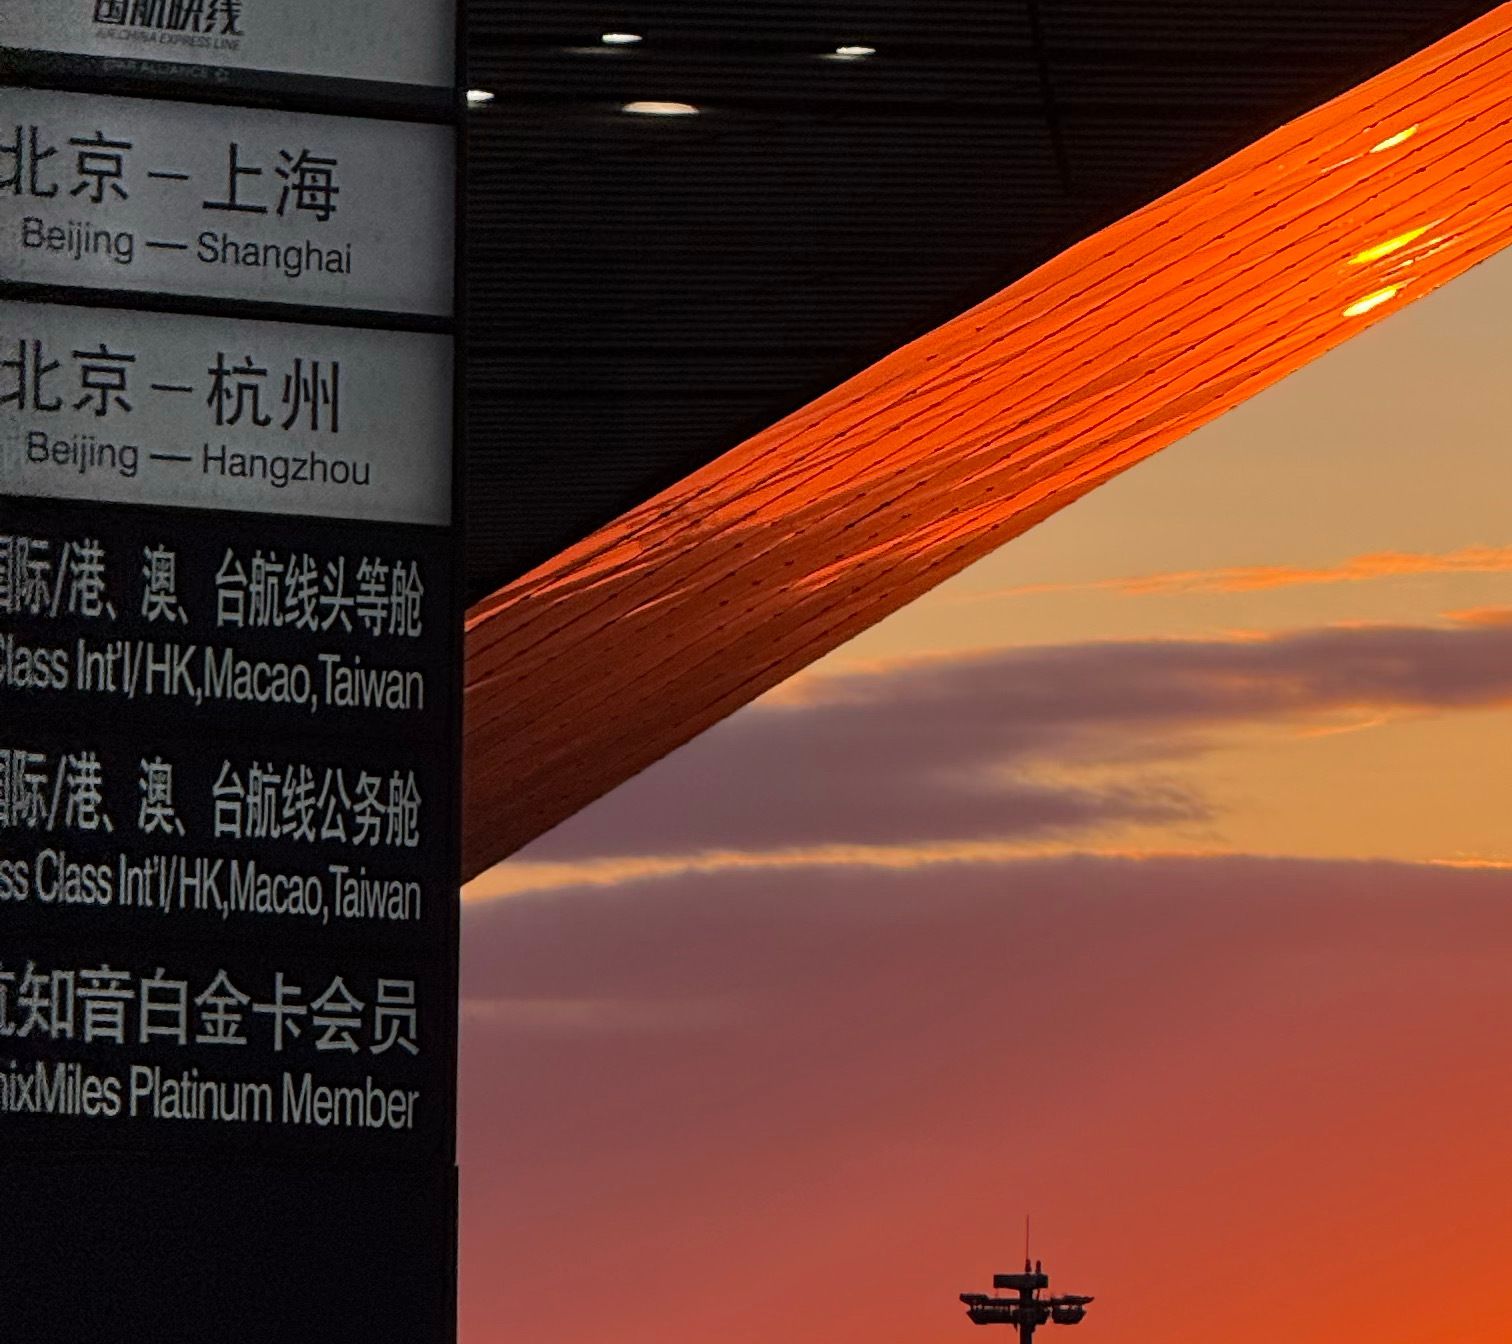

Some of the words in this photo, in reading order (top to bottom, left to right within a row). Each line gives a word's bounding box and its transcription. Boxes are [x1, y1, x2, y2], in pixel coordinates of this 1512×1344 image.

[22, 216, 134, 264] Beijing
[197, 231, 352, 277] Shanghai
[27, 430, 139, 478] Beijing
[202, 443, 371, 488] Hangzhou
[0, 631, 70, 691] lass
[35, 847, 113, 906] Class
[129, 1064, 273, 1123] Platinum
[281, 1071, 420, 1130] Member
